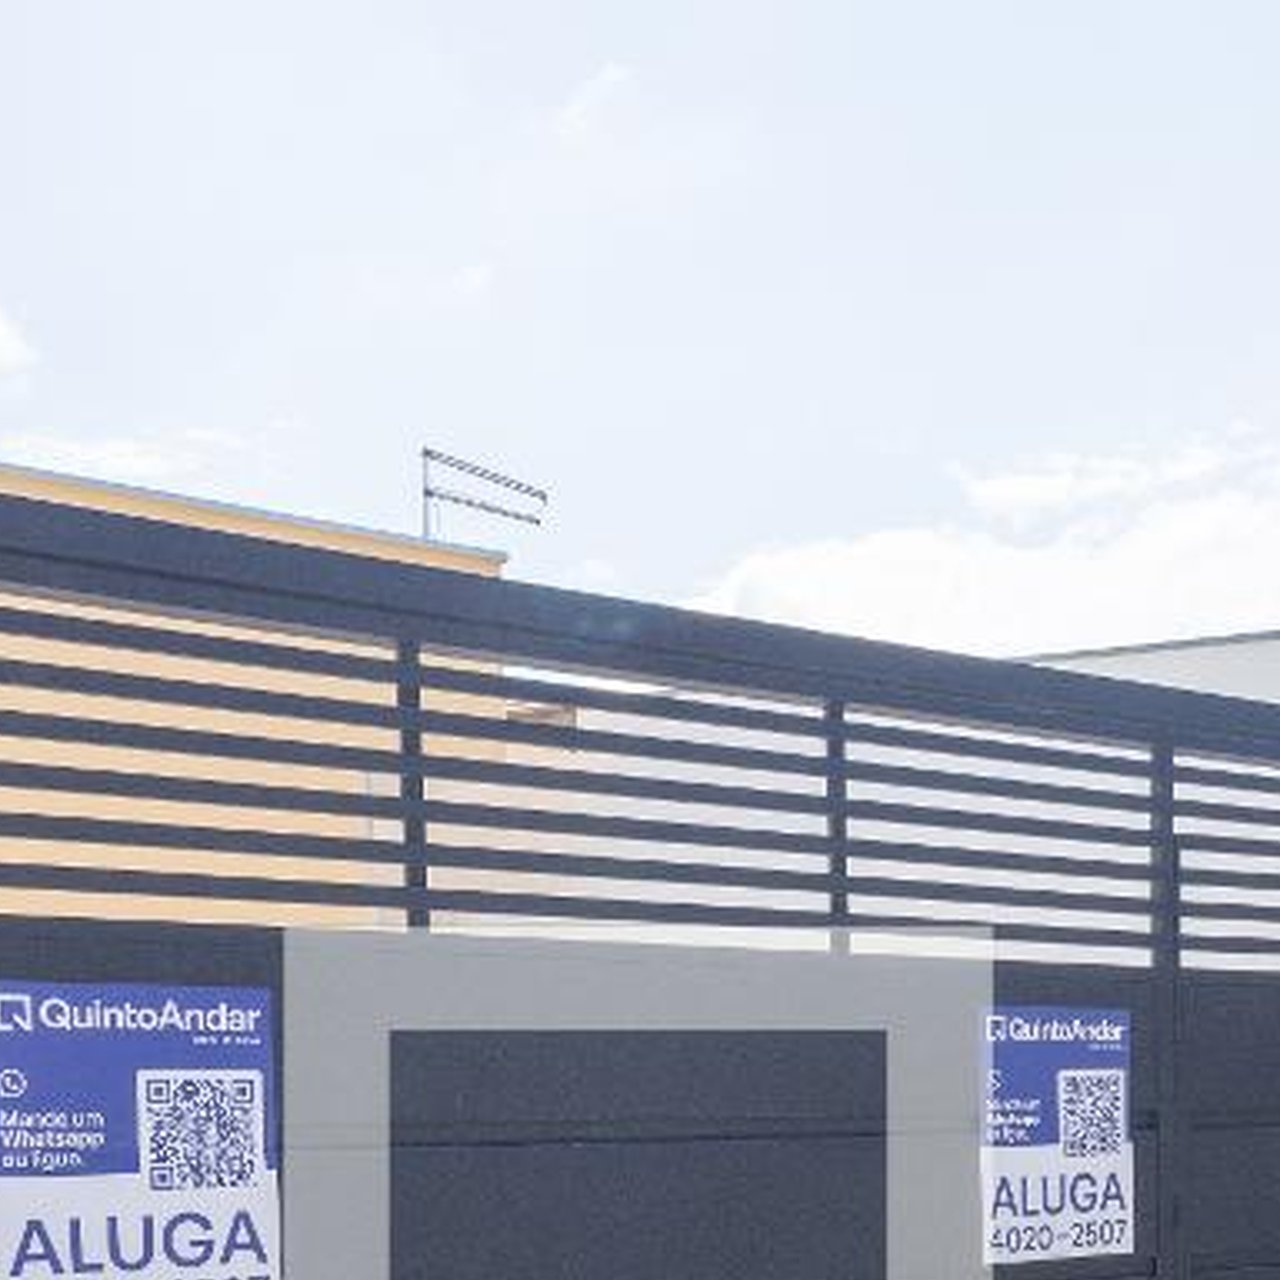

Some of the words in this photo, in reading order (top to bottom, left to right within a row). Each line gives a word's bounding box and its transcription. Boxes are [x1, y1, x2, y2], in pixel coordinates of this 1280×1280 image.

[38, 996, 262, 1032] QuintoAndar
[1008, 1016, 1127, 1042] QuintoAndar
[71, 1111, 105, 1128] um
[991, 1172, 1128, 1220] ALUGA
[9, 1210, 269, 1277] ALUGA
[990, 1219, 1128, 1254] 4020-2507
